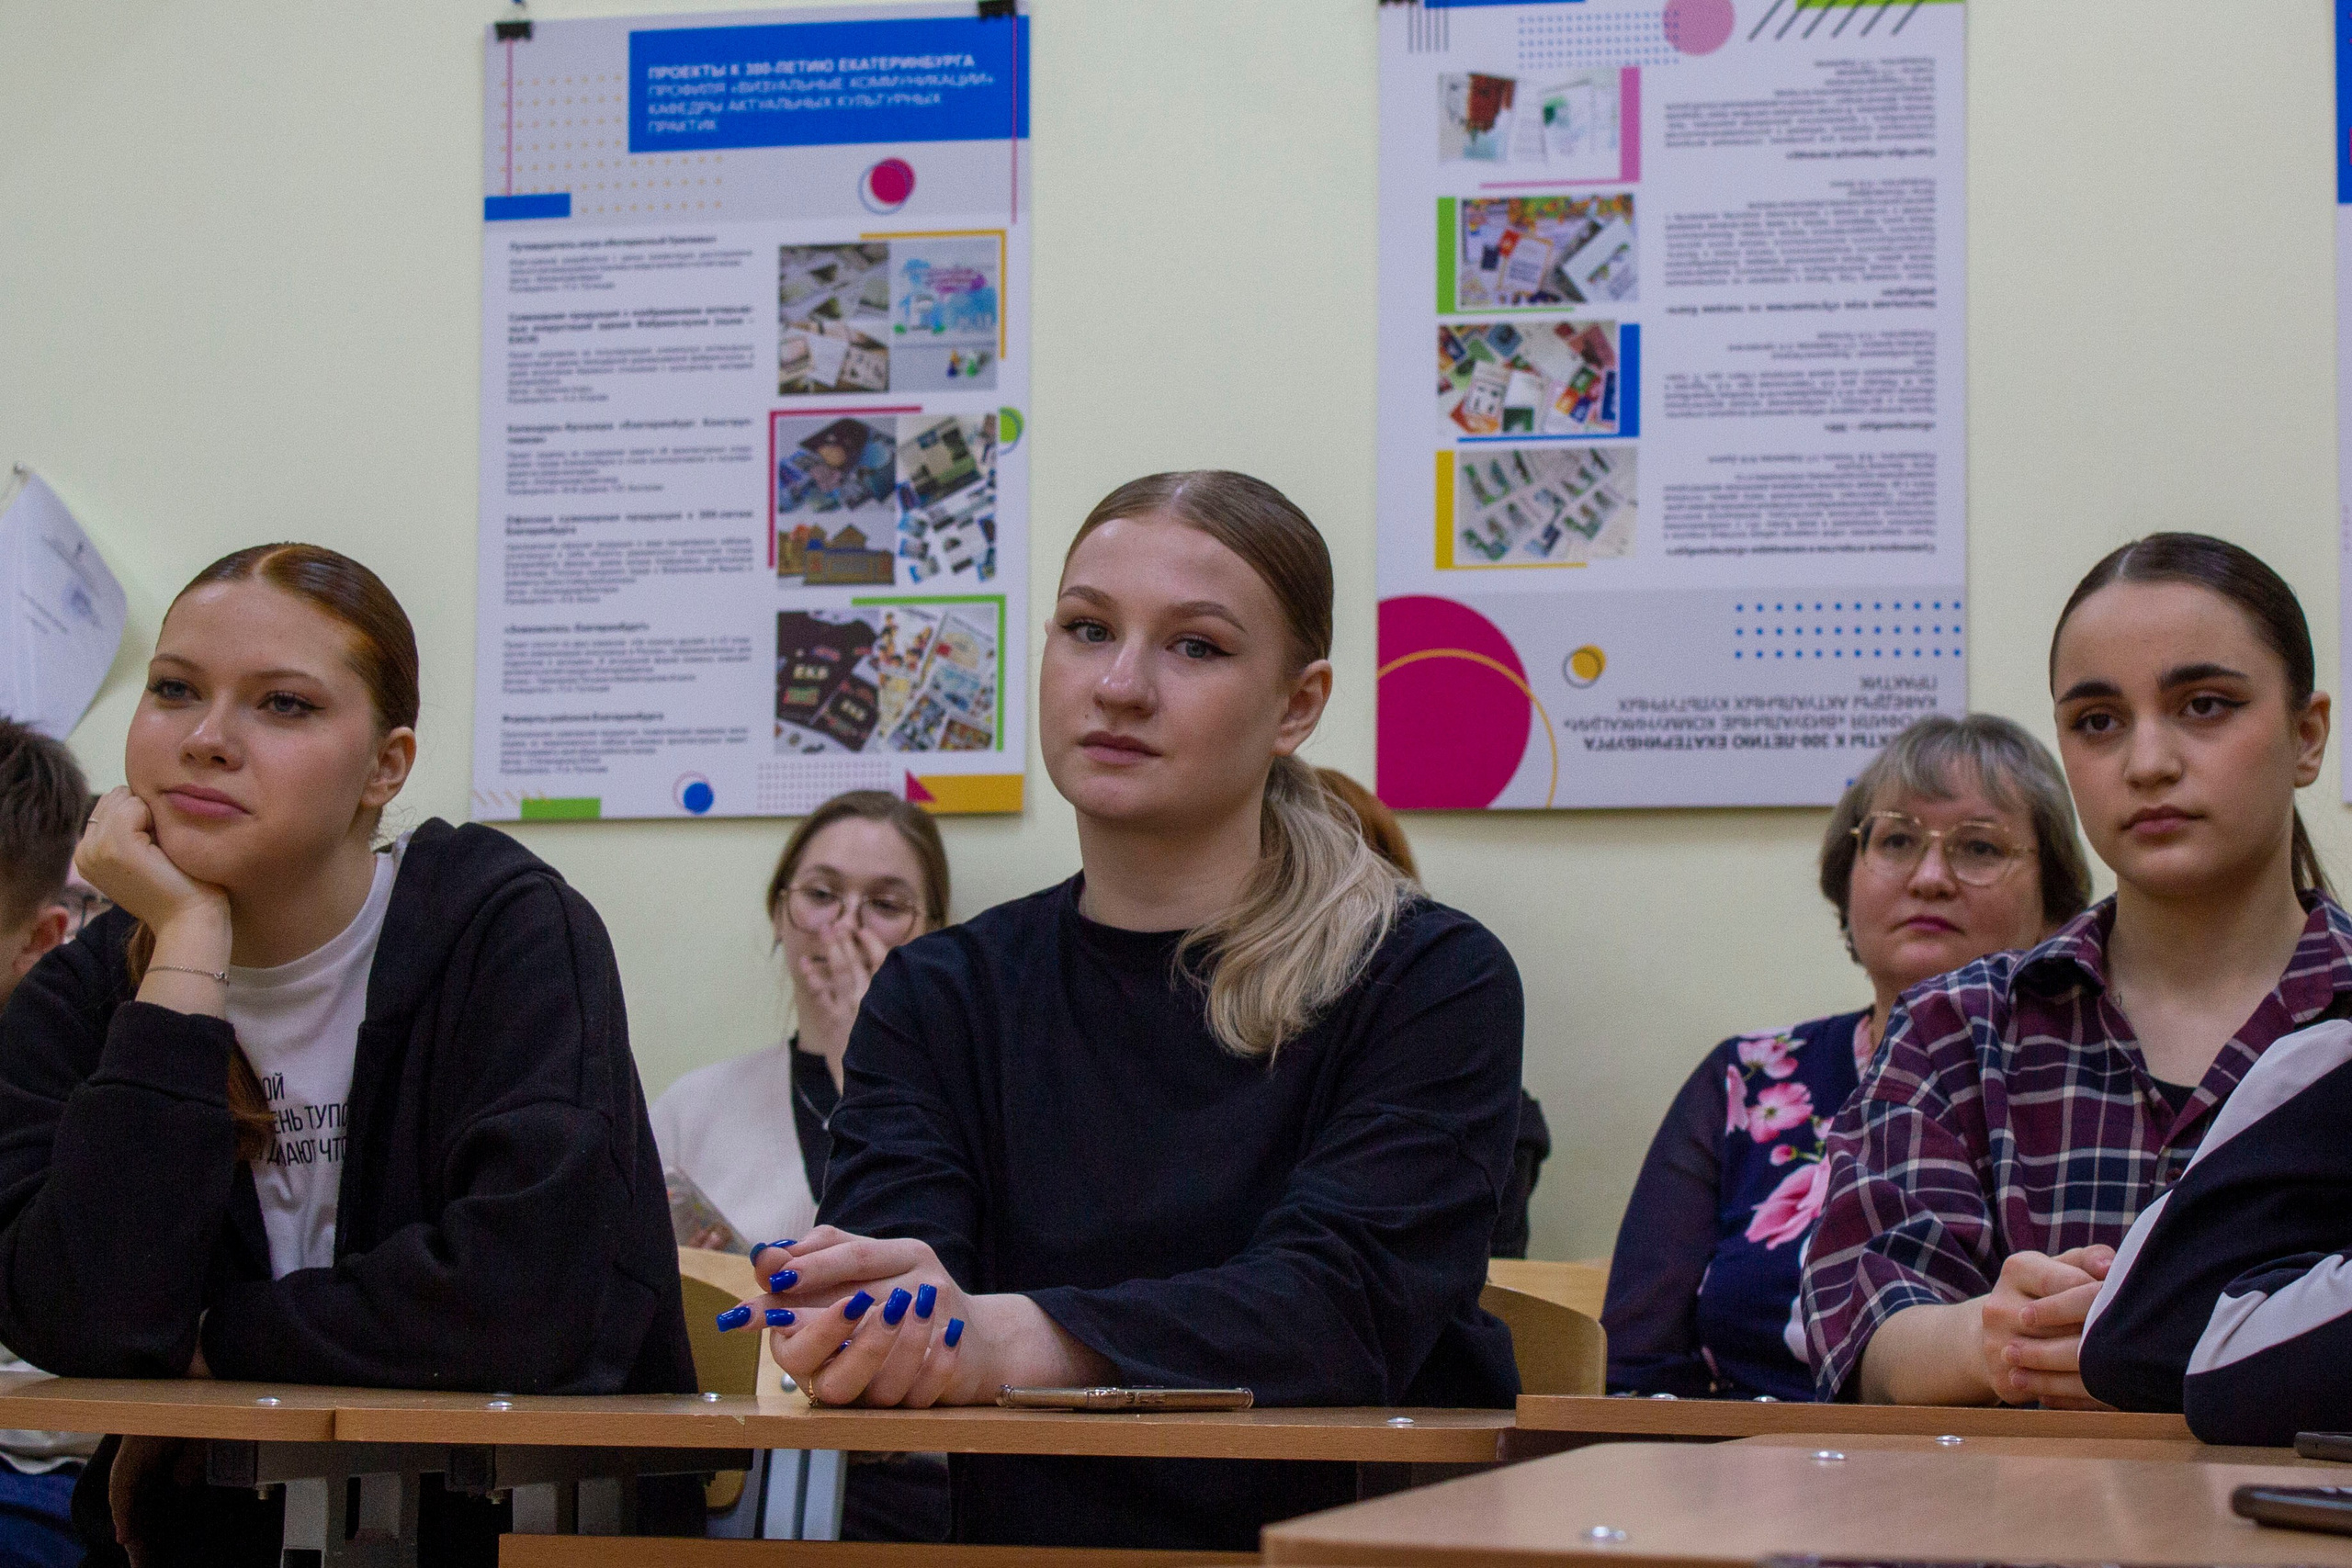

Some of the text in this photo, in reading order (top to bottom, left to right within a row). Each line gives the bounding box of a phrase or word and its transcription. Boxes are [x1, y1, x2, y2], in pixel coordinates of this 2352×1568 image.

[648, 64, 726, 79] ПРОЕКТЫ
[838, 53, 976, 71] ЕКАТЕРИНБУРГА
[1860, 675, 1938, 691] ПРАКТИК
[1619, 696, 1729, 713] КУЛЬТУРНЫХ
[1735, 695, 1849, 712] АКТУАЛЬНЫХ
[1584, 736, 1726, 751] ЕКАТЕРИНБУРГА
[1732, 735, 1828, 750] 300-ЛЕТИЮ
[1836, 736, 1847, 749] К
